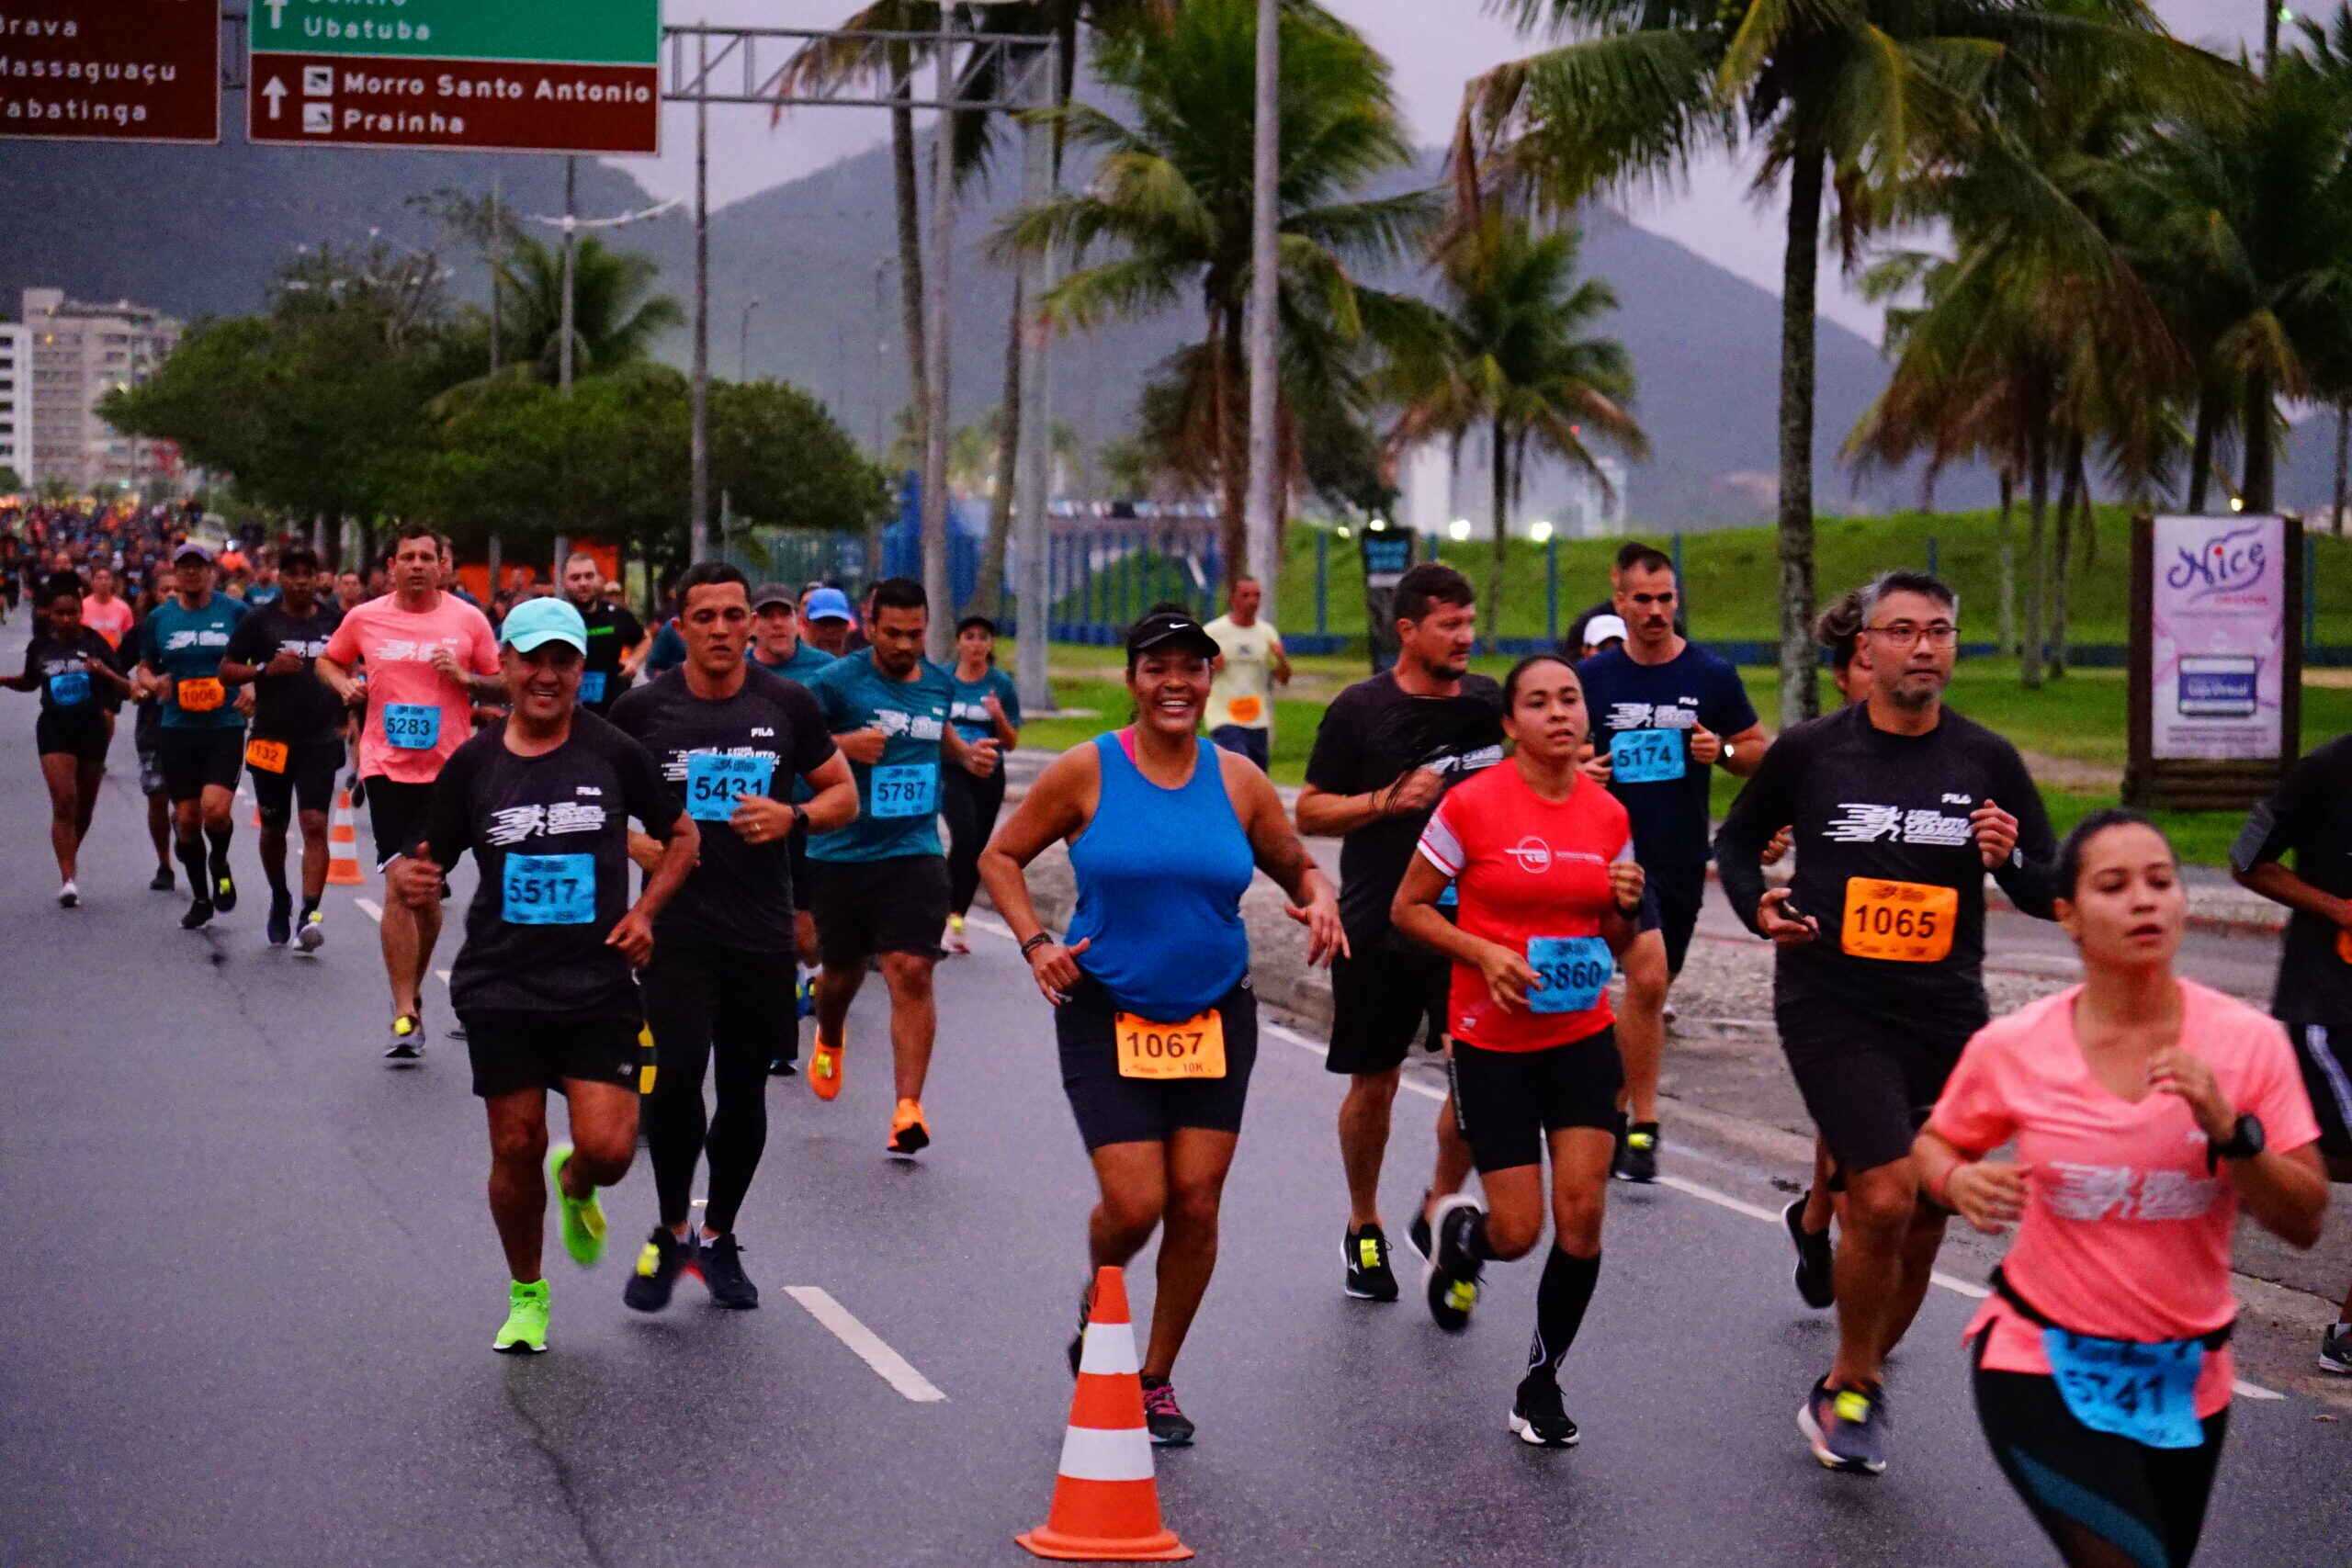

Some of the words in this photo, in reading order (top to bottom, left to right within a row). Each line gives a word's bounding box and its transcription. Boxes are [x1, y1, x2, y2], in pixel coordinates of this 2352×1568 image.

[304, 16, 430, 40] Ubatuba
[345, 73, 424, 96] Morro
[437, 74, 524, 98] Santo
[535, 79, 650, 103] Antonio
[0, 97, 147, 126] abatinga
[345, 108, 464, 133] Prainha
[2167, 527, 2267, 595] Nice
[386, 716, 431, 736] 5283
[751, 728, 775, 738] FILA
[1617, 745, 1673, 768] 5174
[694, 776, 763, 802] 5431
[877, 781, 926, 802] 5787
[508, 877, 579, 905] 5517
[1853, 904, 1937, 939] 1065
[1537, 960, 1603, 992] 5860
[1126, 1032, 1204, 1058] 1067
[1182, 1062, 1204, 1074] 10K
